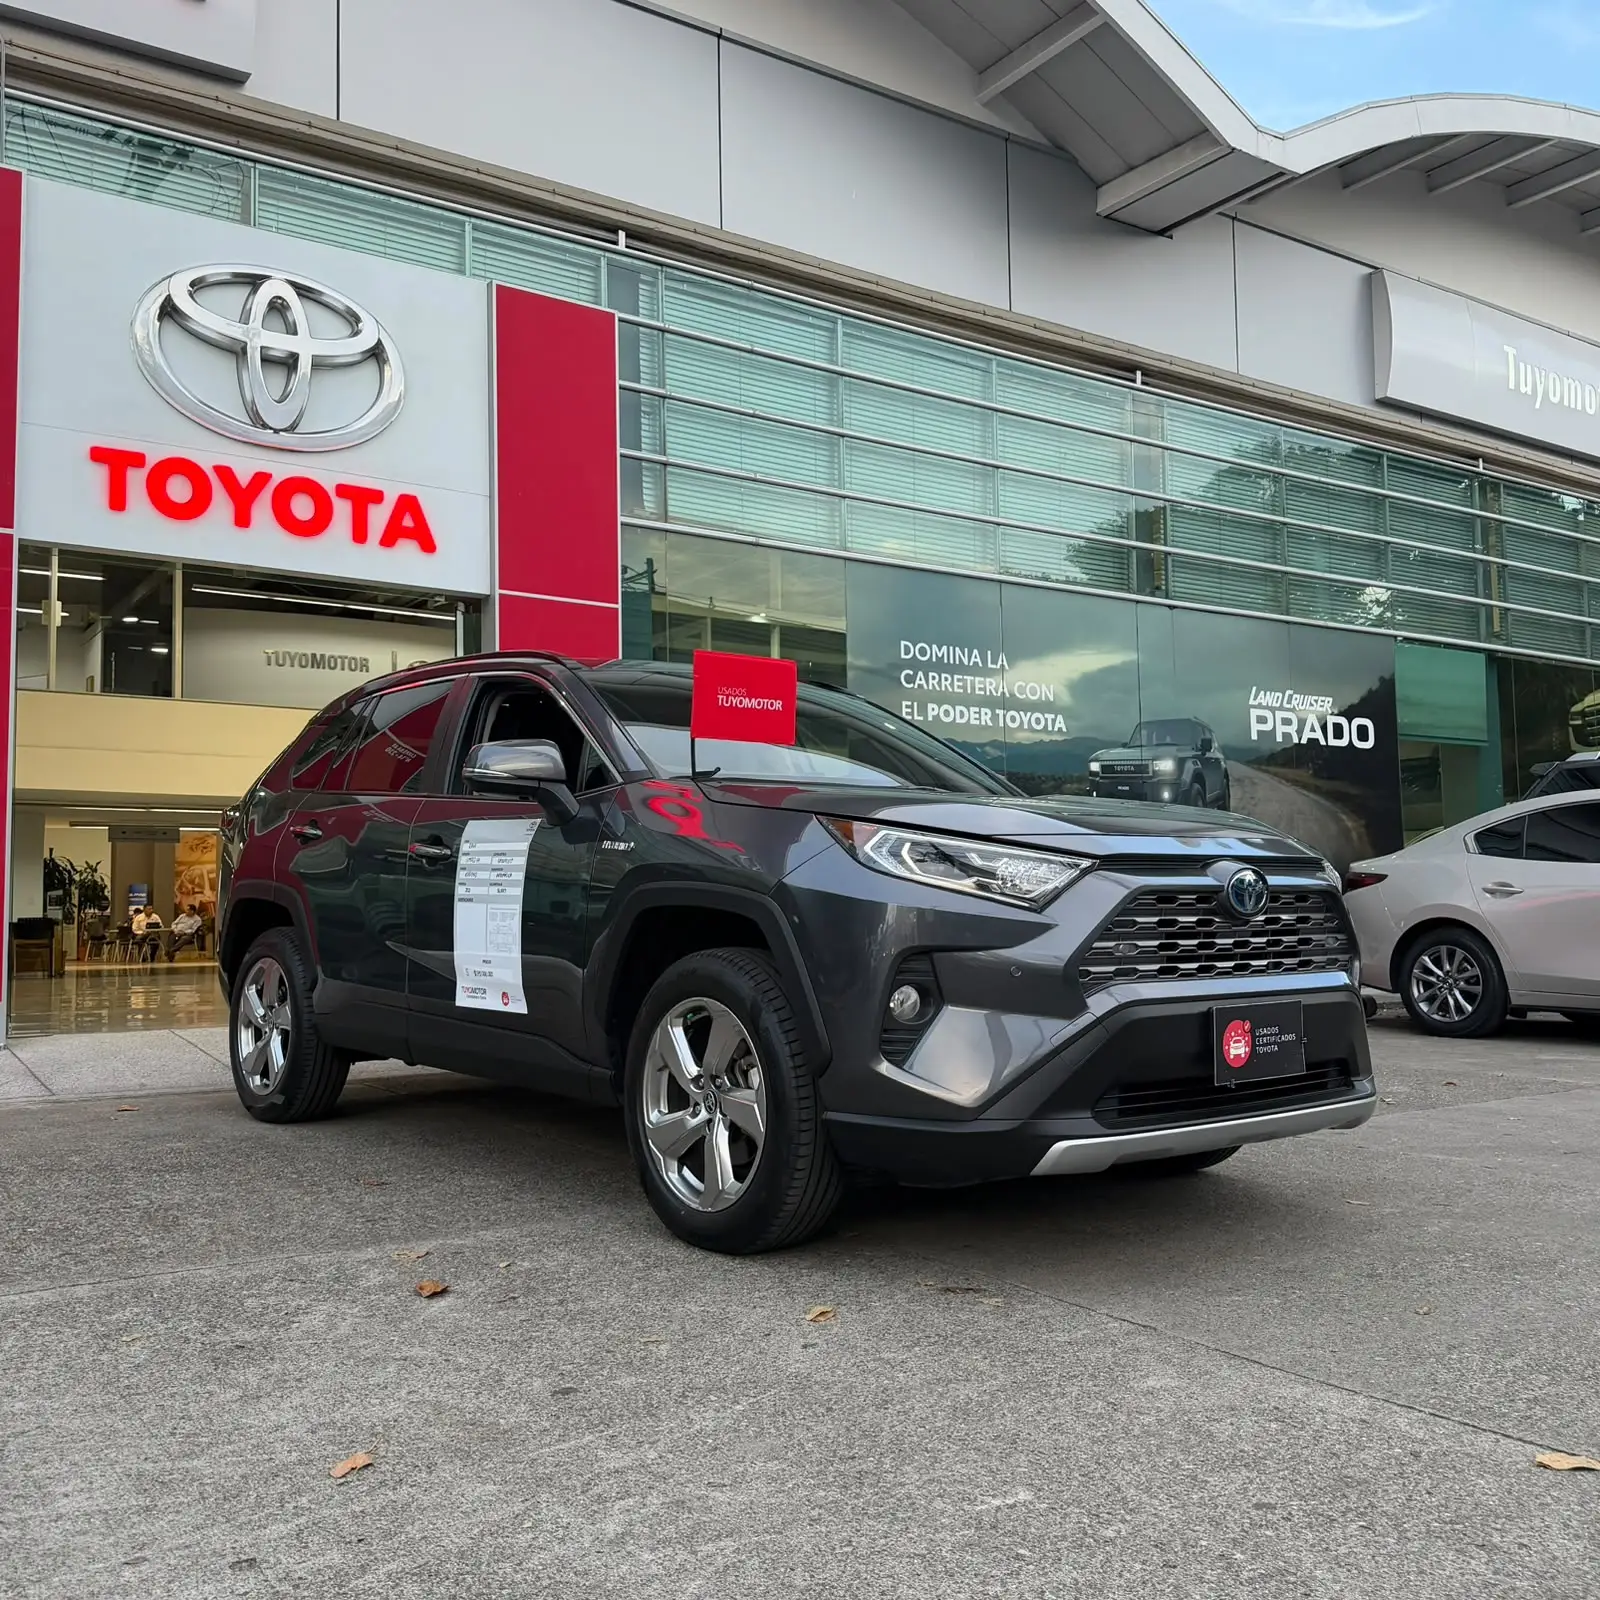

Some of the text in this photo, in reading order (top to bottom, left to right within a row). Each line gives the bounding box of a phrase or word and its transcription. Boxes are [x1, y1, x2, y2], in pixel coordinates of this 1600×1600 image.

[1503, 344, 1600, 416] Tuyomo
[90, 446, 436, 553] TOYOTA
[264, 650, 370, 673] TUYOMOTOR
[900, 640, 1009, 670] DOMINA LA
[717, 686, 747, 696] USADOS
[900, 669, 1054, 701] CARRETERA CON
[717, 695, 782, 711] TUYOMOTOR
[1283, 690, 1333, 713] CRUISER
[902, 700, 1067, 732] EL PODER TOYOTA
[1250, 708, 1375, 749] PRADO
[1255, 1026, 1279, 1036] USADOS
[1255, 1033, 1296, 1045] CERTIFICADOS
[1256, 1044, 1279, 1054] TOYOTA
